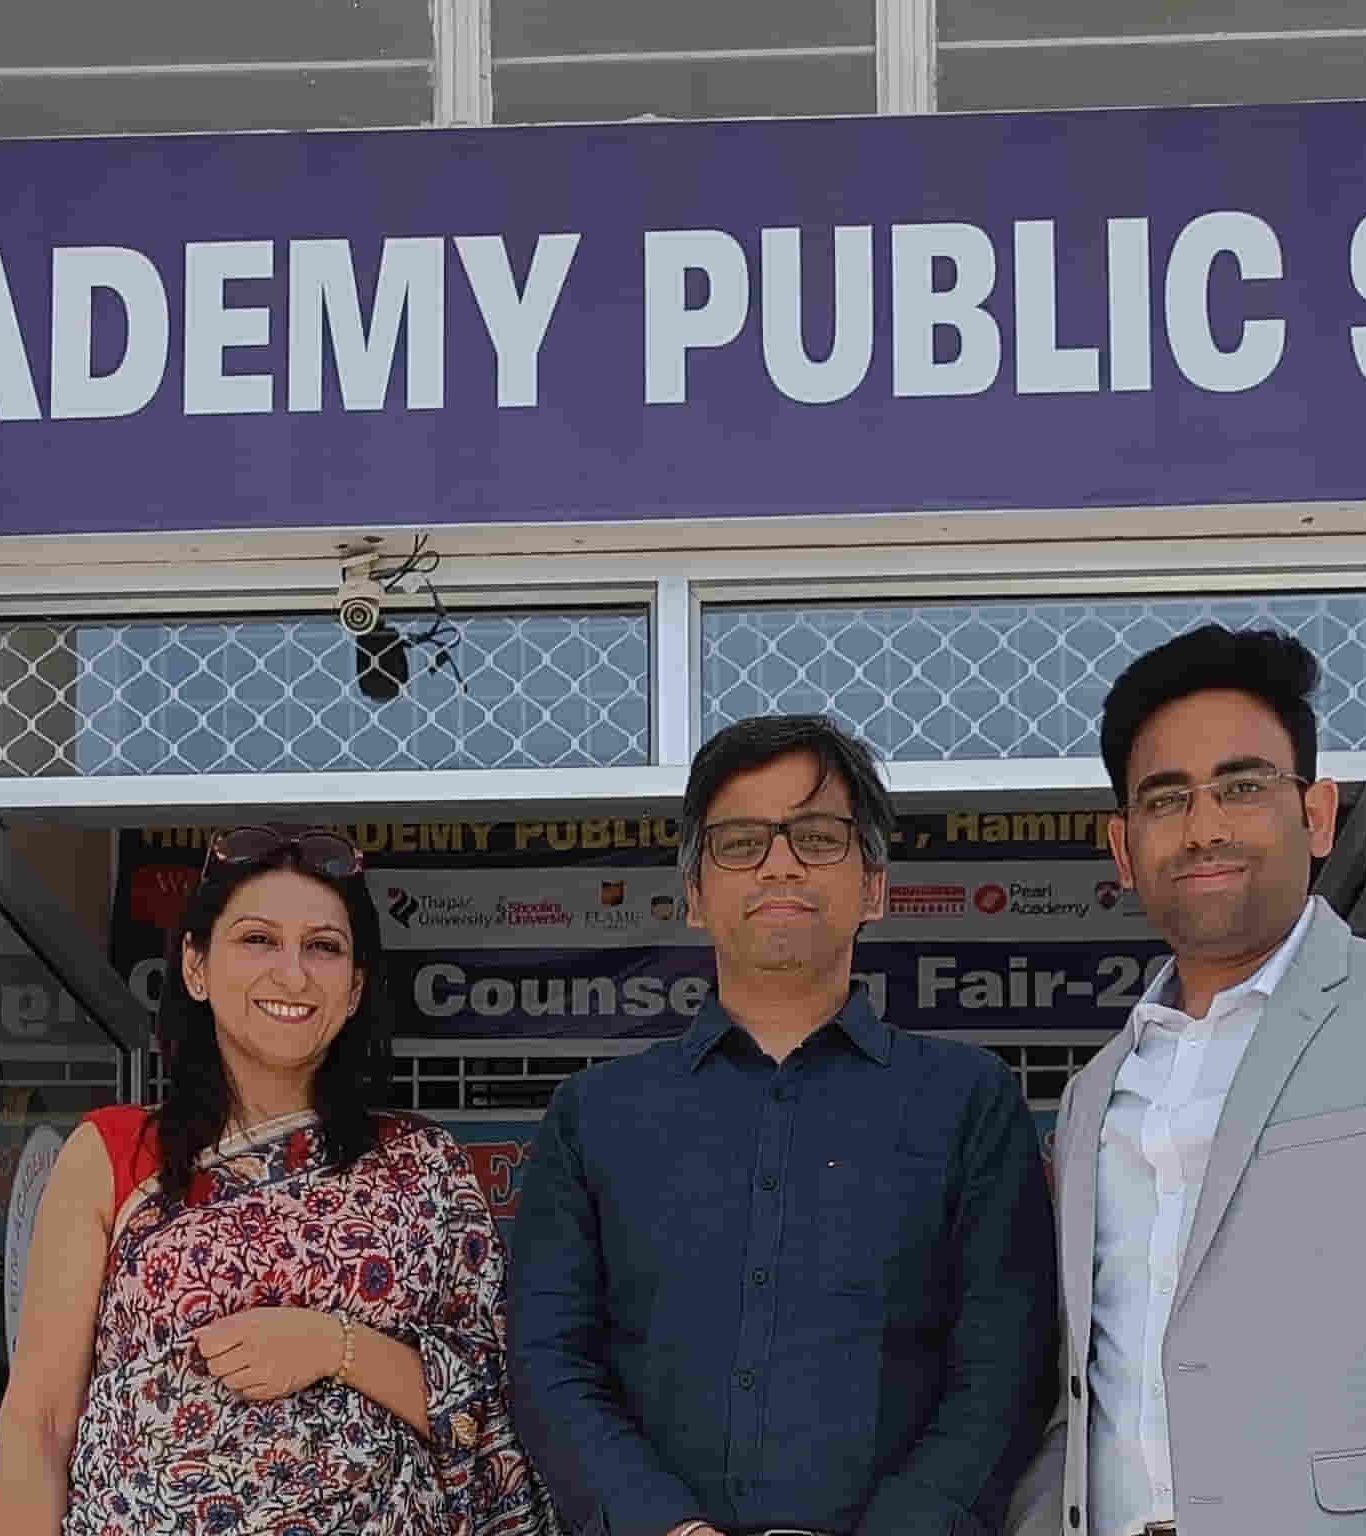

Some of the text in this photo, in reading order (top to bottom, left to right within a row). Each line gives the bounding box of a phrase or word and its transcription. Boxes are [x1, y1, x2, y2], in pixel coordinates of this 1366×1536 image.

[645, 212, 1285, 403] PUBLIC
[946, 808, 1111, 849] Hamir
[1010, 882, 1053, 898] Pearl
[418, 911, 493, 929] University
[507, 912, 571, 927] University
[1010, 903, 1091, 919] Academy
[916, 956, 1165, 1010] Fair-2
